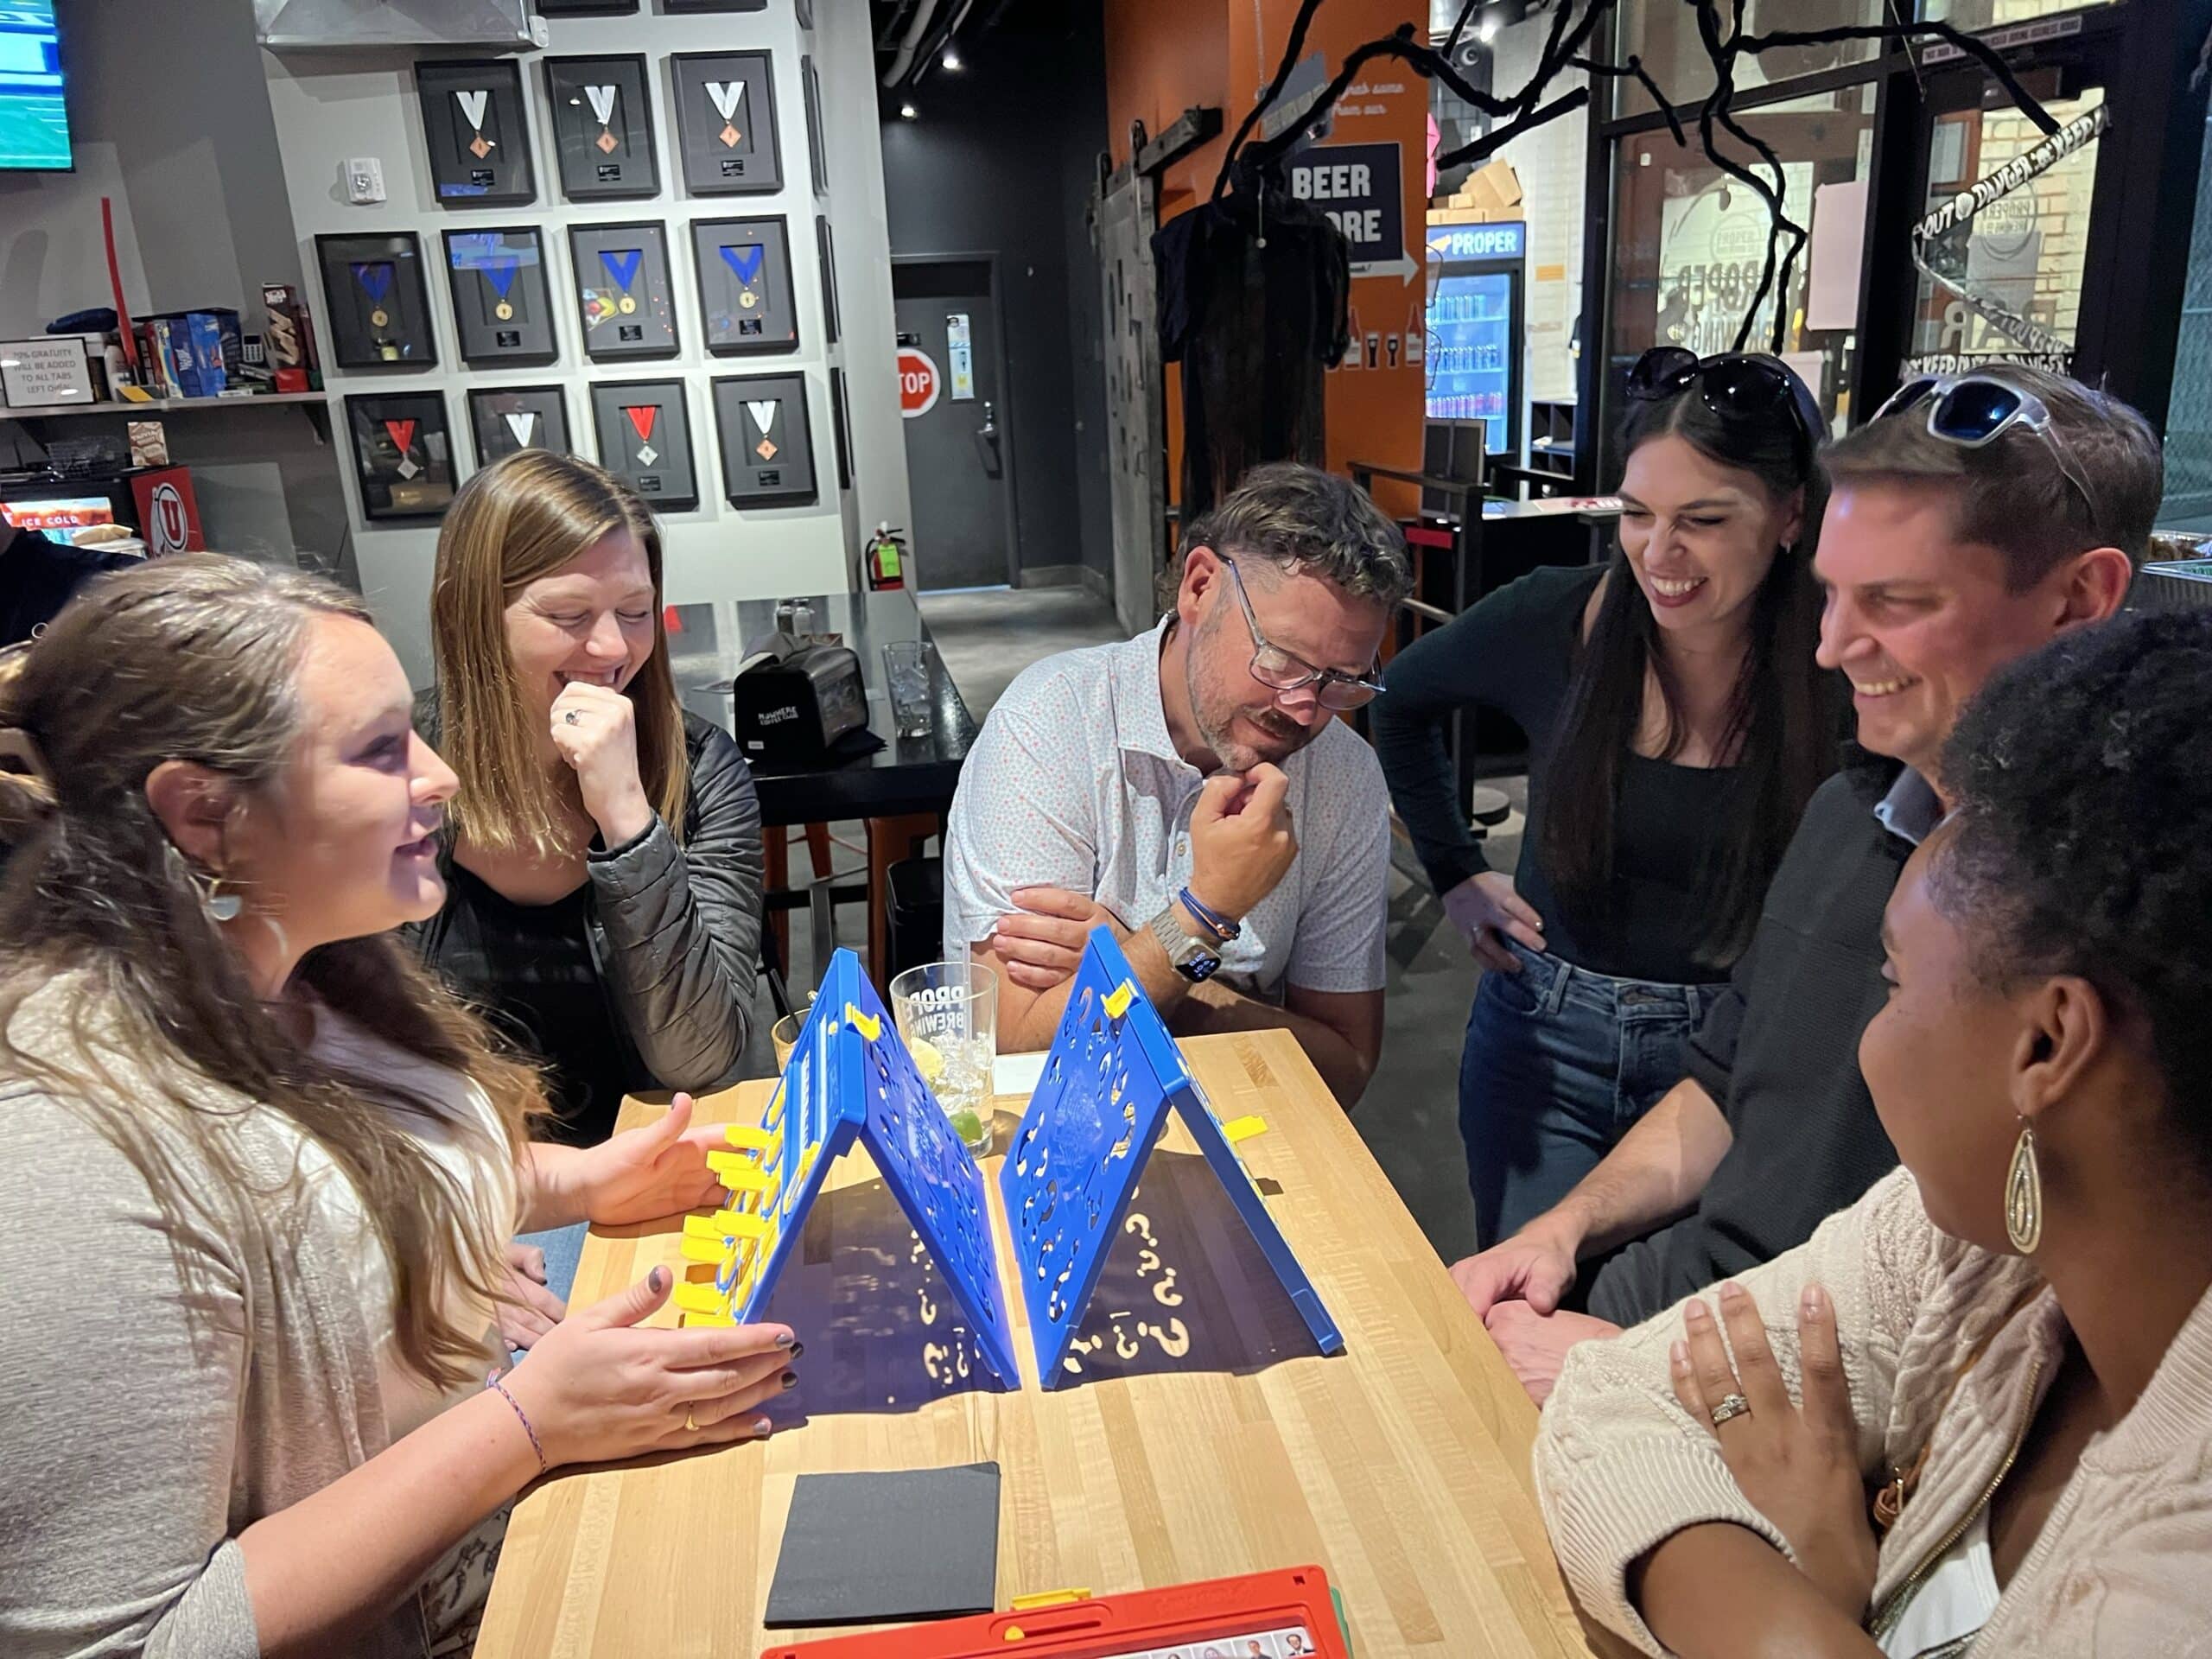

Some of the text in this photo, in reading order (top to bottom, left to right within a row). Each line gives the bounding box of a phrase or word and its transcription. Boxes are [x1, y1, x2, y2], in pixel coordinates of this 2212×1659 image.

[1971, 155, 2031, 208] DANGER
[2050, 116, 2094, 161] KEEP
[1292, 164, 1371, 200] BEER
[1452, 229, 1517, 256] PROPER
[899, 372, 931, 394] TOP
[21, 515, 79, 527] ICE COLD
